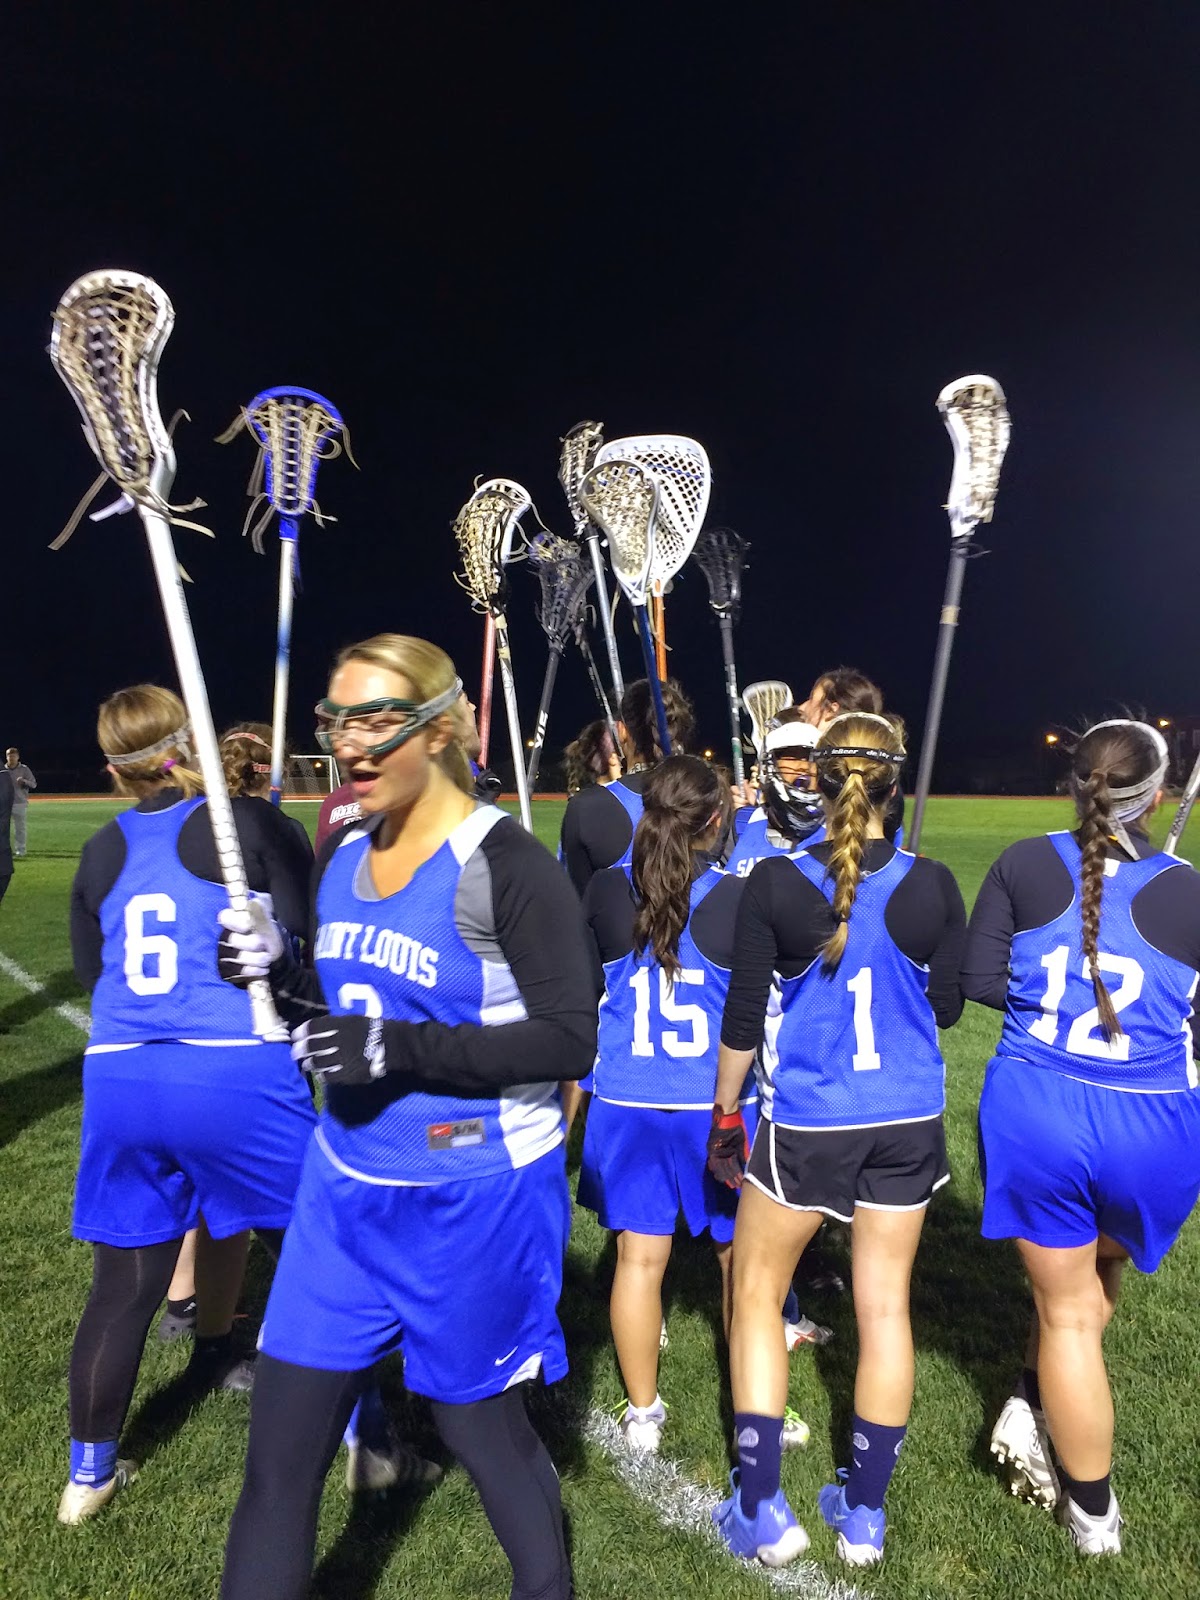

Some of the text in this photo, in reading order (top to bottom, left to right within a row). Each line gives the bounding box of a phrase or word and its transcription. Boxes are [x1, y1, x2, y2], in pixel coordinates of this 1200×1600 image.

[736, 856, 766, 879] SA
[124, 892, 179, 996] 6
[314, 921, 439, 989] AINT LOUIS
[629, 966, 710, 1058] 15
[847, 966, 881, 1072] 1
[1027, 945, 1145, 1061] 12
